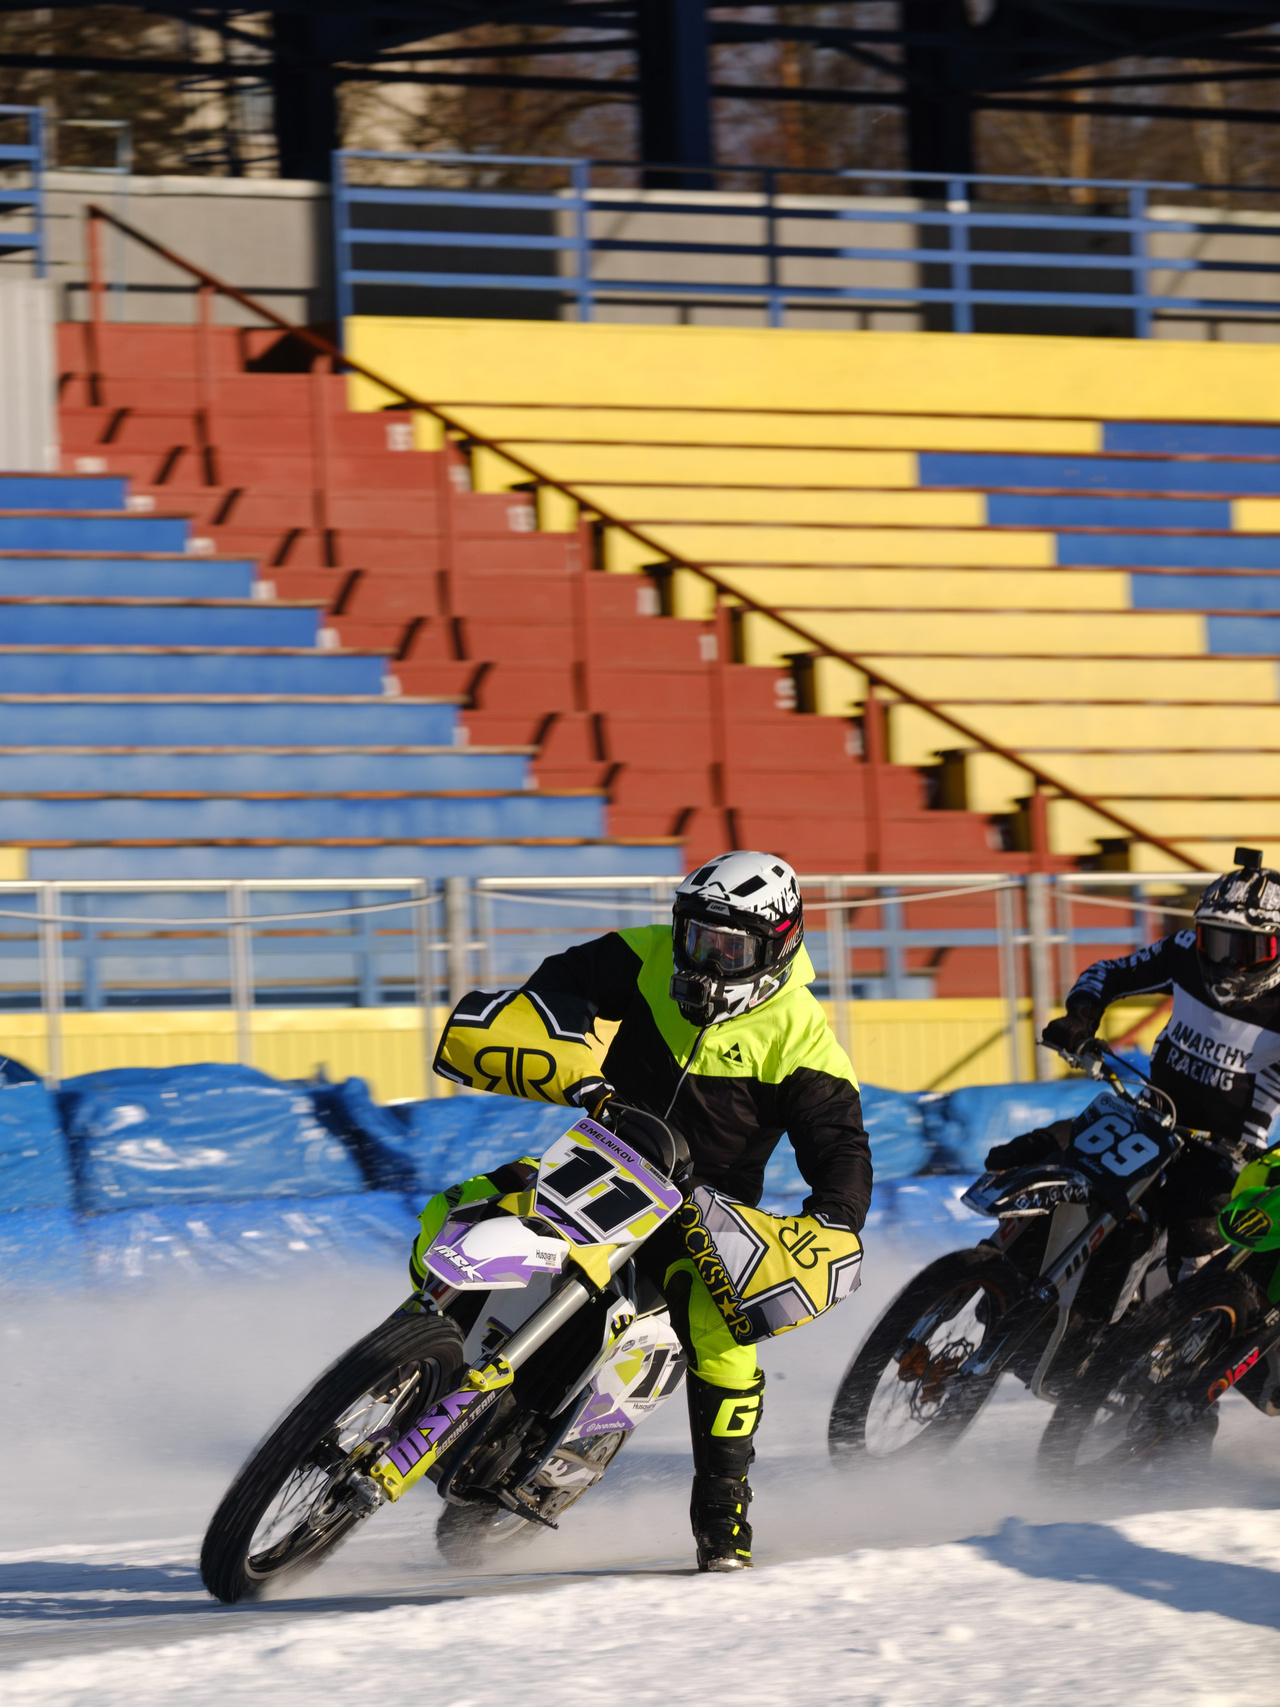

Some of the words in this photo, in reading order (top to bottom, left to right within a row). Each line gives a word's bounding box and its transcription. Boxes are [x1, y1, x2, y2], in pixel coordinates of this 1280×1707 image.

[1166, 1046, 1235, 1091] RACING
[1171, 1020, 1253, 1069] ANARCHY
[578, 1122, 636, 1164] D.MELNIKOV
[1073, 1113, 1160, 1177] 69
[540, 1144, 659, 1235] 11
[435, 1419, 469, 1458] RACING
[469, 1389, 497, 1421] TEAM
[710, 1395, 761, 1438] G
